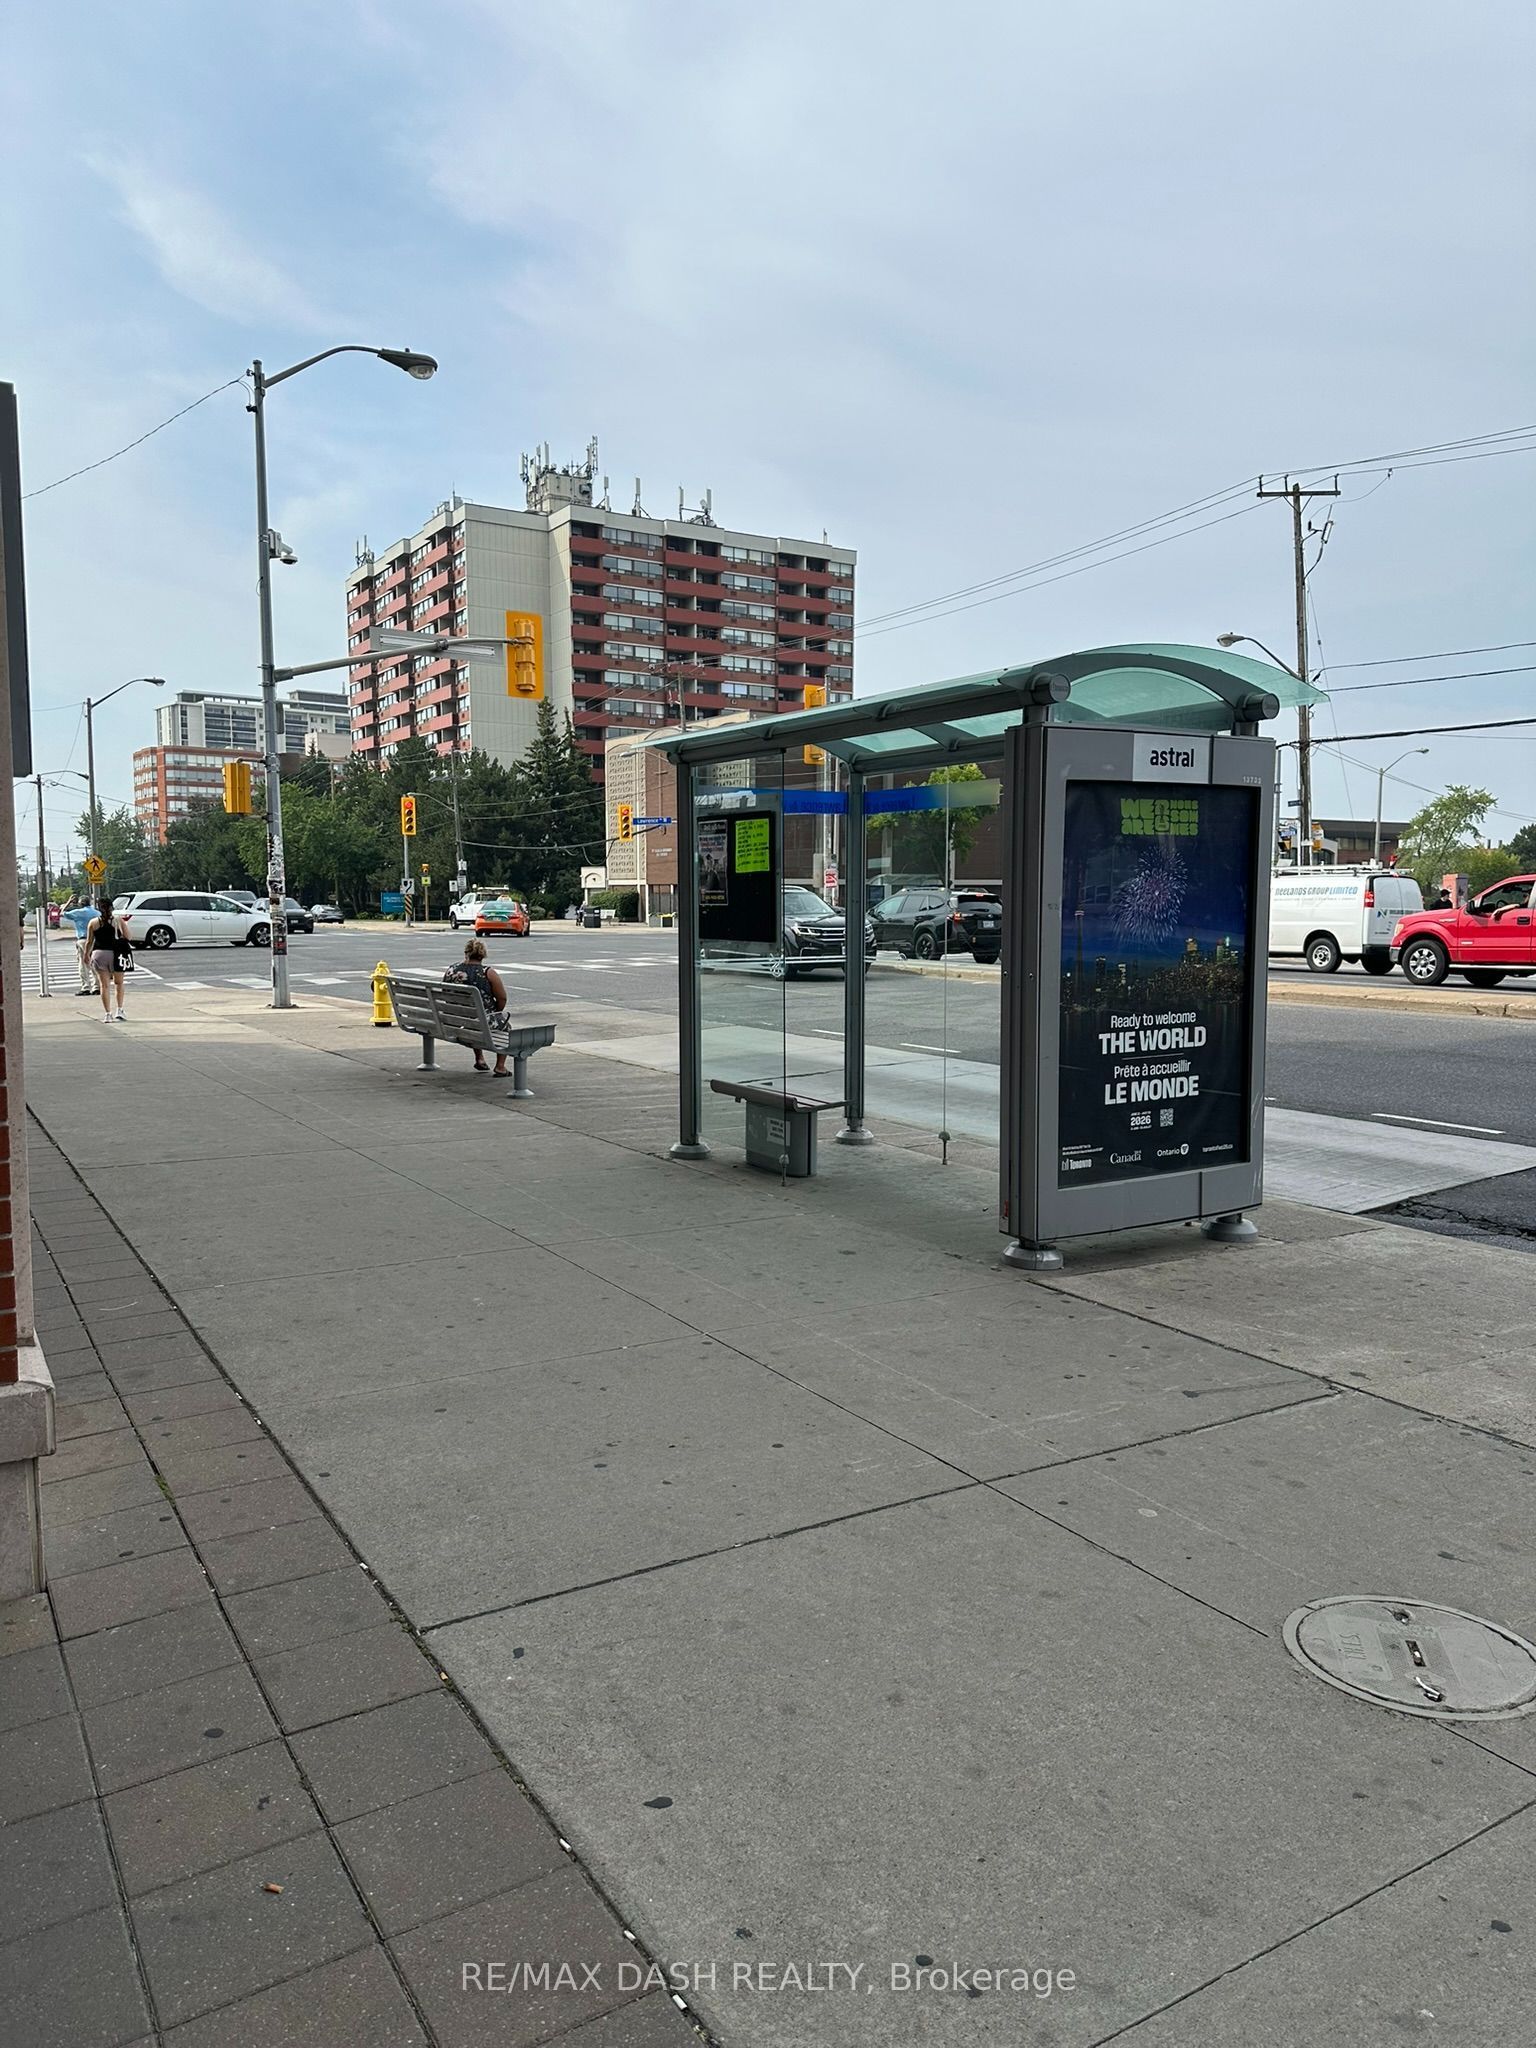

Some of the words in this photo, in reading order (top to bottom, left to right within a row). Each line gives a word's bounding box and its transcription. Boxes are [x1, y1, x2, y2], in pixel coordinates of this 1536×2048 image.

[1149, 747, 1195, 768] astral
[1110, 1014, 1141, 1029] Ready
[1142, 1013, 1154, 1026] to
[1155, 1011, 1196, 1025] welcome
[1098, 1031, 1136, 1055] THE
[1139, 1026, 1207, 1051] WORLD
[1114, 1065, 1140, 1079] Prête
[1142, 1063, 1149, 1077] à
[1150, 1060, 1191, 1075] accueillir
[1104, 1082, 1128, 1106] LE
[1130, 1075, 1200, 1103] MONDE
[1130, 1115, 1152, 1126] 2026
[1109, 1150, 1142, 1164] Canada
[1156, 1147, 1181, 1157] Ontario
